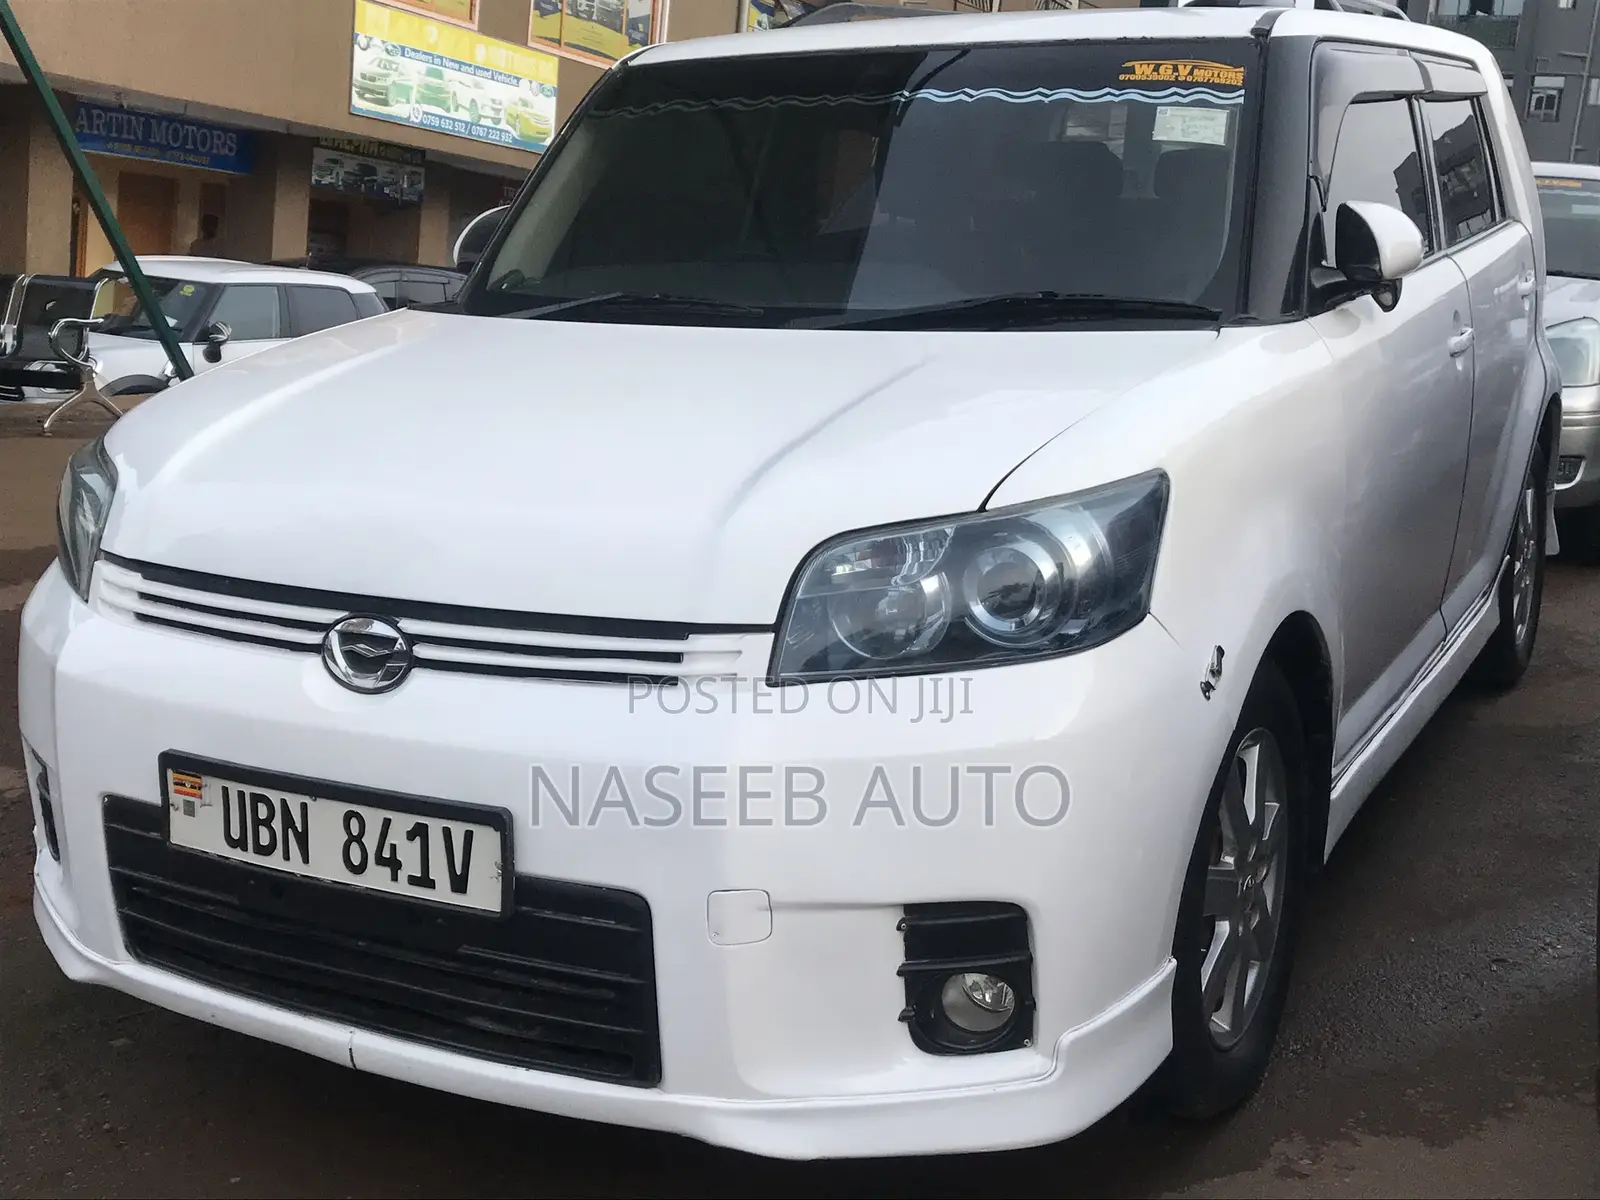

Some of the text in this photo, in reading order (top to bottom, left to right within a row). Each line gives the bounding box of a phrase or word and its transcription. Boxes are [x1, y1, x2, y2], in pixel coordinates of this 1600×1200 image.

[404, 48, 433, 63] Dealers
[433, 54, 442, 65] in
[443, 57, 460, 71] New
[460, 64, 475, 75] and
[475, 68, 492, 80] used
[1135, 64, 1244, 80] W.G.V MOTORS
[76, 107, 146, 141] ARTIN
[149, 118, 238, 157] MOTORS
[422, 114, 440, 127] 0759
[440, 118, 453, 130] 632
[454, 121, 466, 132] 512
[471, 125, 487, 137] 0767
[488, 128, 500, 140] 222
[500, 131, 513, 143] 932
[221, 785, 474, 895] UBN 841V
